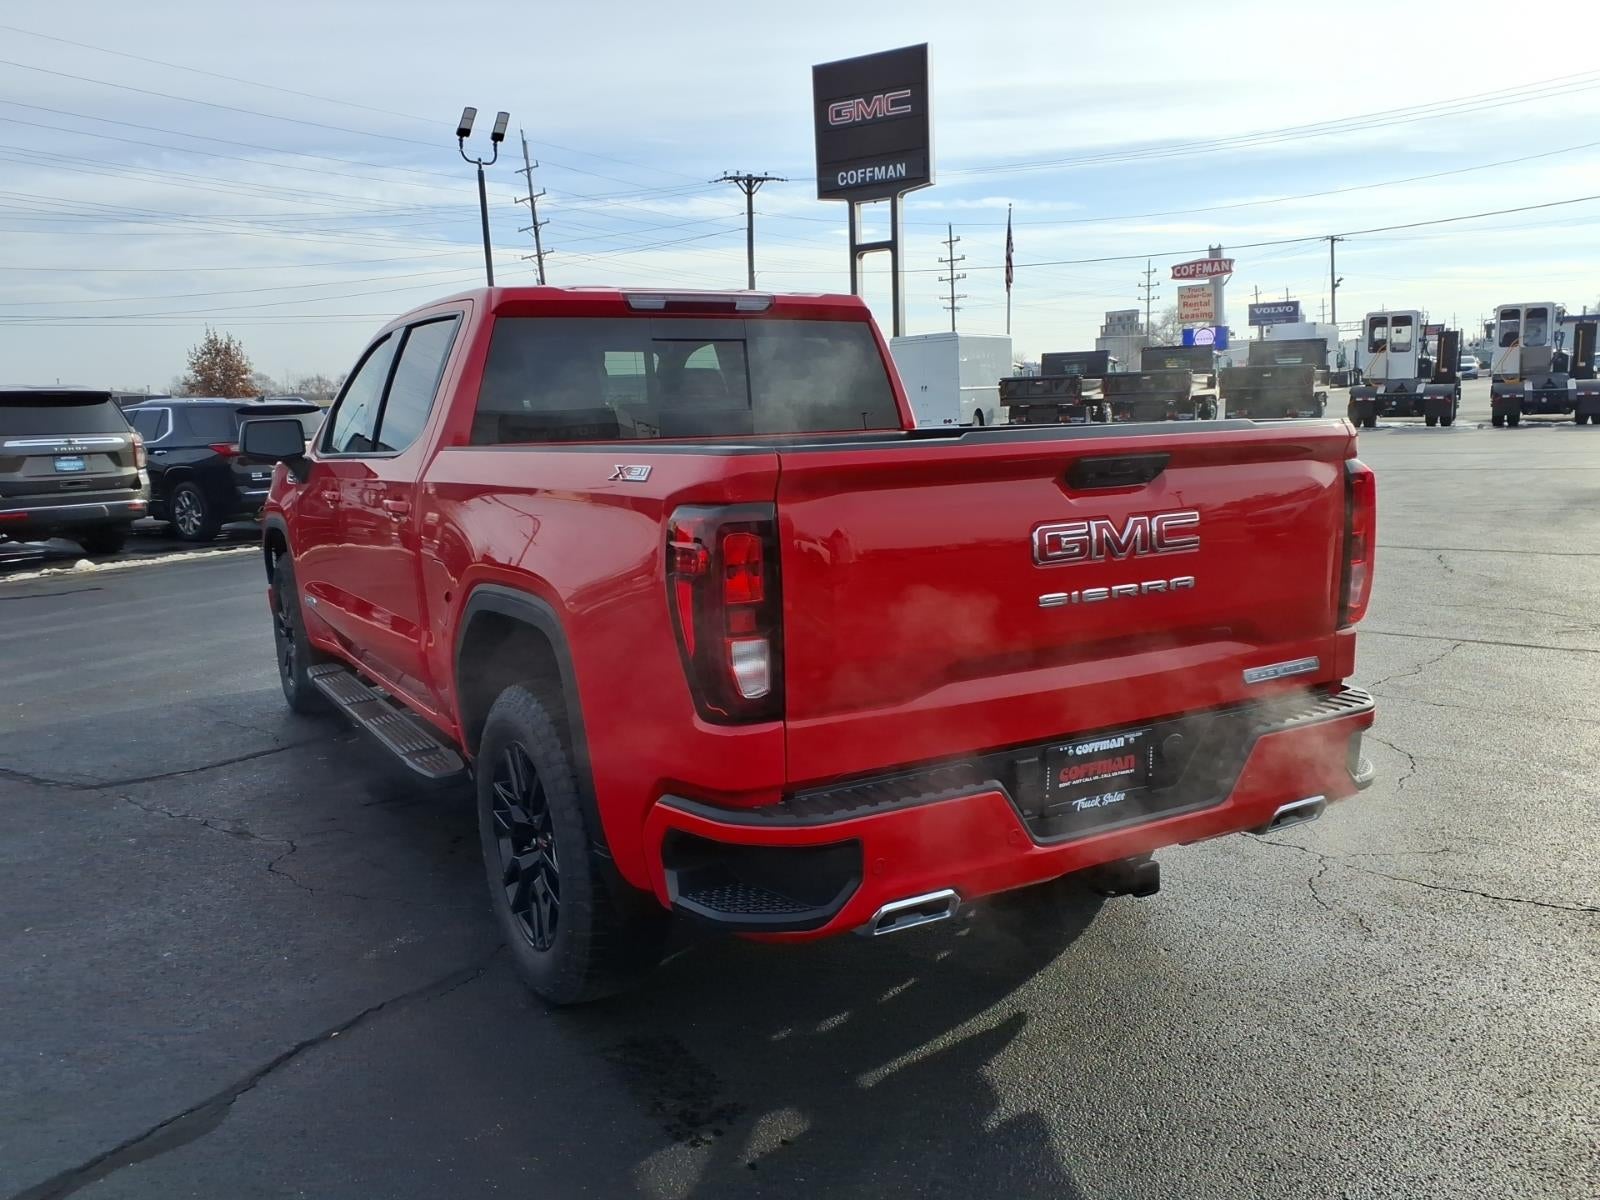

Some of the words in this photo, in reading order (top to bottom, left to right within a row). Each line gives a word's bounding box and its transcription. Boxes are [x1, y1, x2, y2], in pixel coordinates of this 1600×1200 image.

[828, 89, 912, 126] GMC
[837, 162, 906, 186] COFFMAN
[1173, 260, 1230, 277] COFFMAN
[1183, 299, 1210, 308] Rental
[1253, 305, 1294, 314] VOLVO
[1180, 311, 1214, 320] Leasing
[608, 464, 651, 481] X31
[1032, 511, 1200, 565] GMC
[1038, 575, 1195, 608] SIERRA
[1072, 796, 1101, 812] Truck
[1102, 791, 1126, 806] Sales
